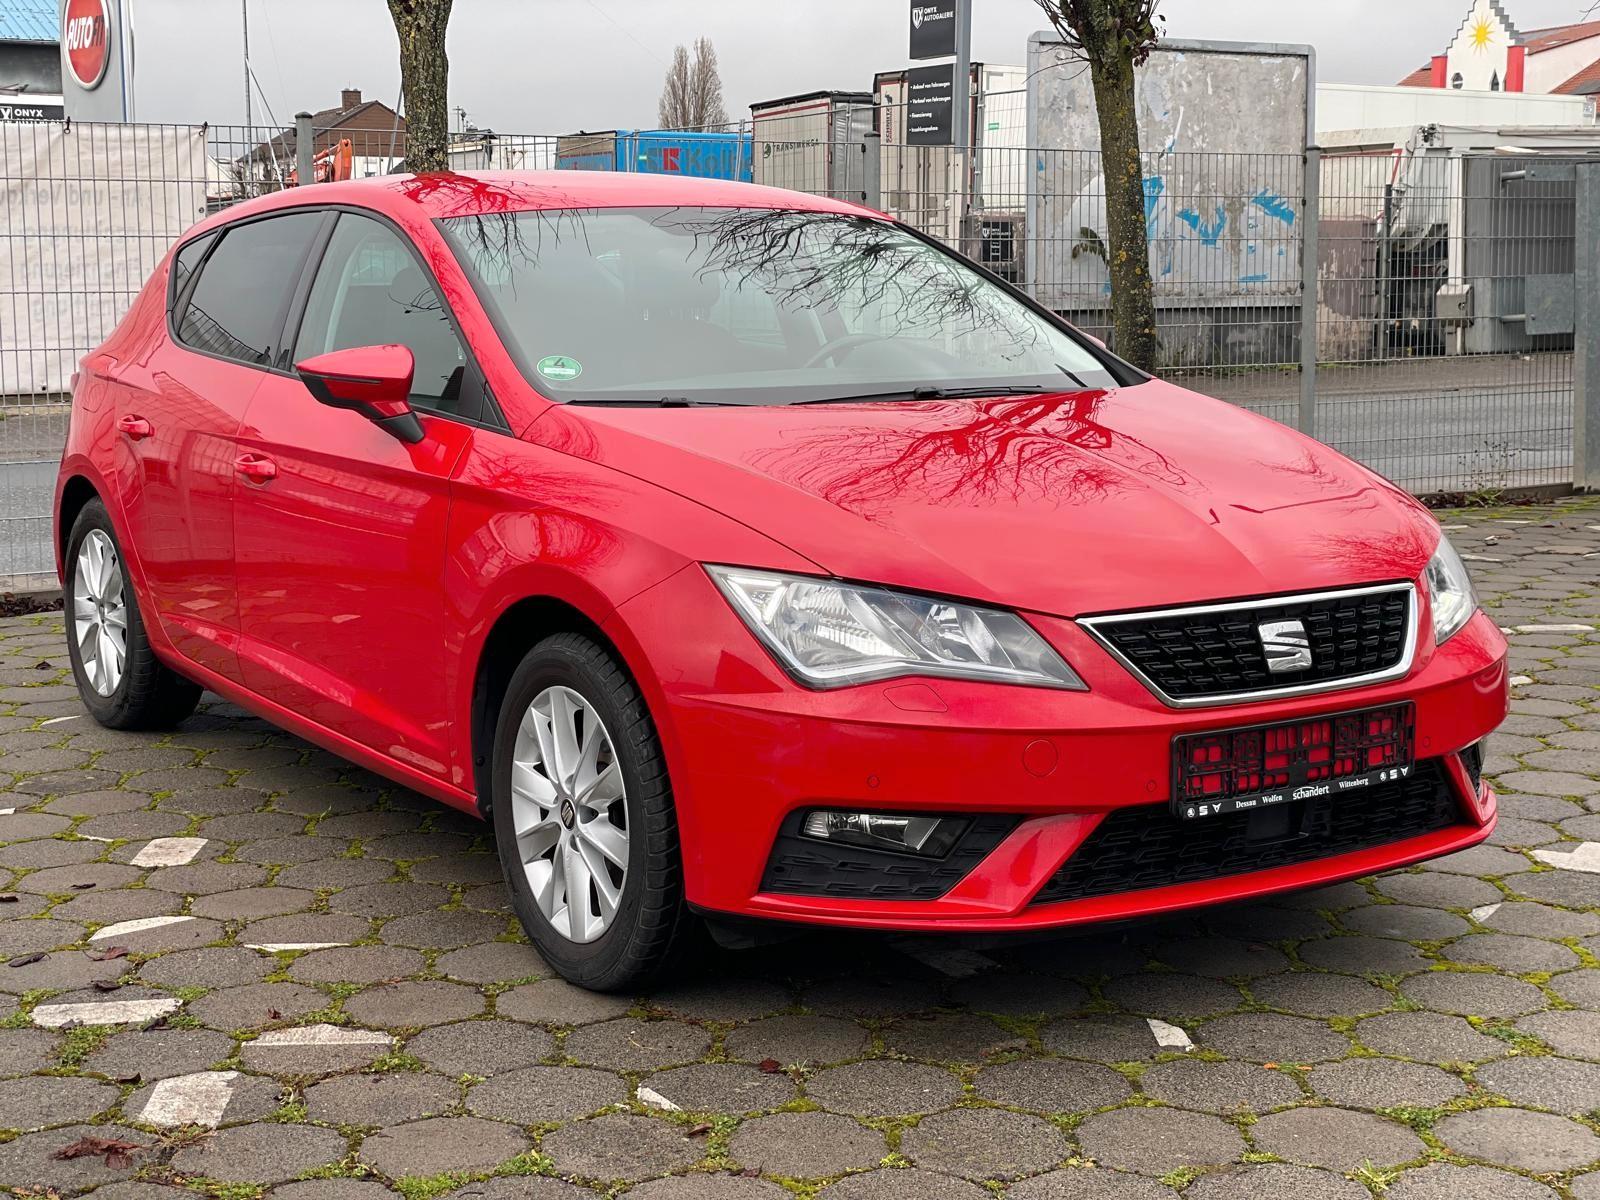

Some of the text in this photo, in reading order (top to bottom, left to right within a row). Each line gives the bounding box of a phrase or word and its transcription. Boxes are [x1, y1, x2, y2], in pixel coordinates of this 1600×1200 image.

[14, 108, 44, 117] ONYX
[1235, 800, 1257, 809] Dessau
[1262, 794, 1283, 804] Wolfen
[1292, 785, 1330, 800] schandert
[1339, 778, 1369, 789] Wittenberg
